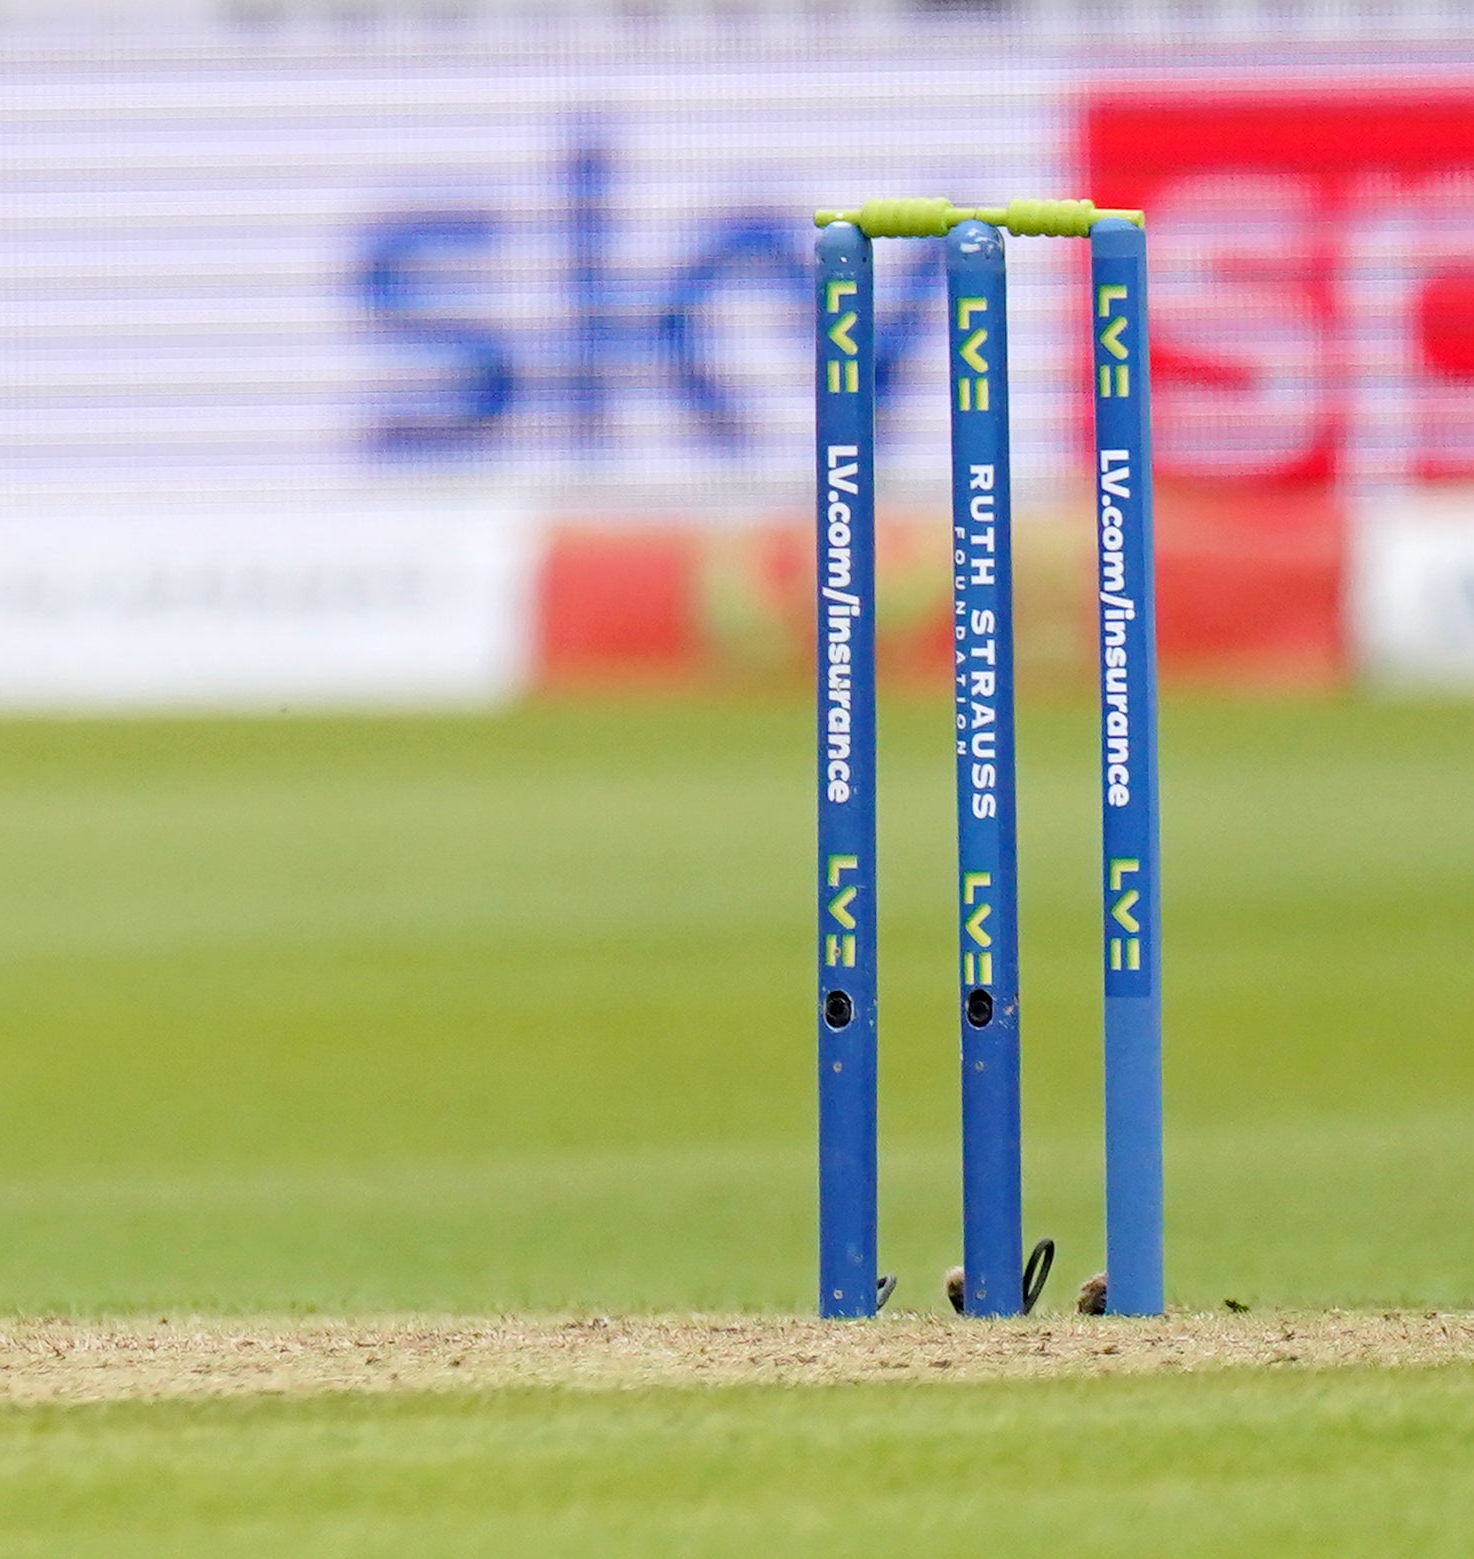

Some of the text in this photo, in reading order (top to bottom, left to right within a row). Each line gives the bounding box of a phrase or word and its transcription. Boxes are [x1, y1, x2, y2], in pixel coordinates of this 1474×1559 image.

[822, 444, 861, 804] LV.com/insurance
[954, 525, 967, 756] FOUNDATION
[969, 463, 997, 820] RUTH STRAUSS
[1100, 448, 1136, 808] LV.com/insurance
